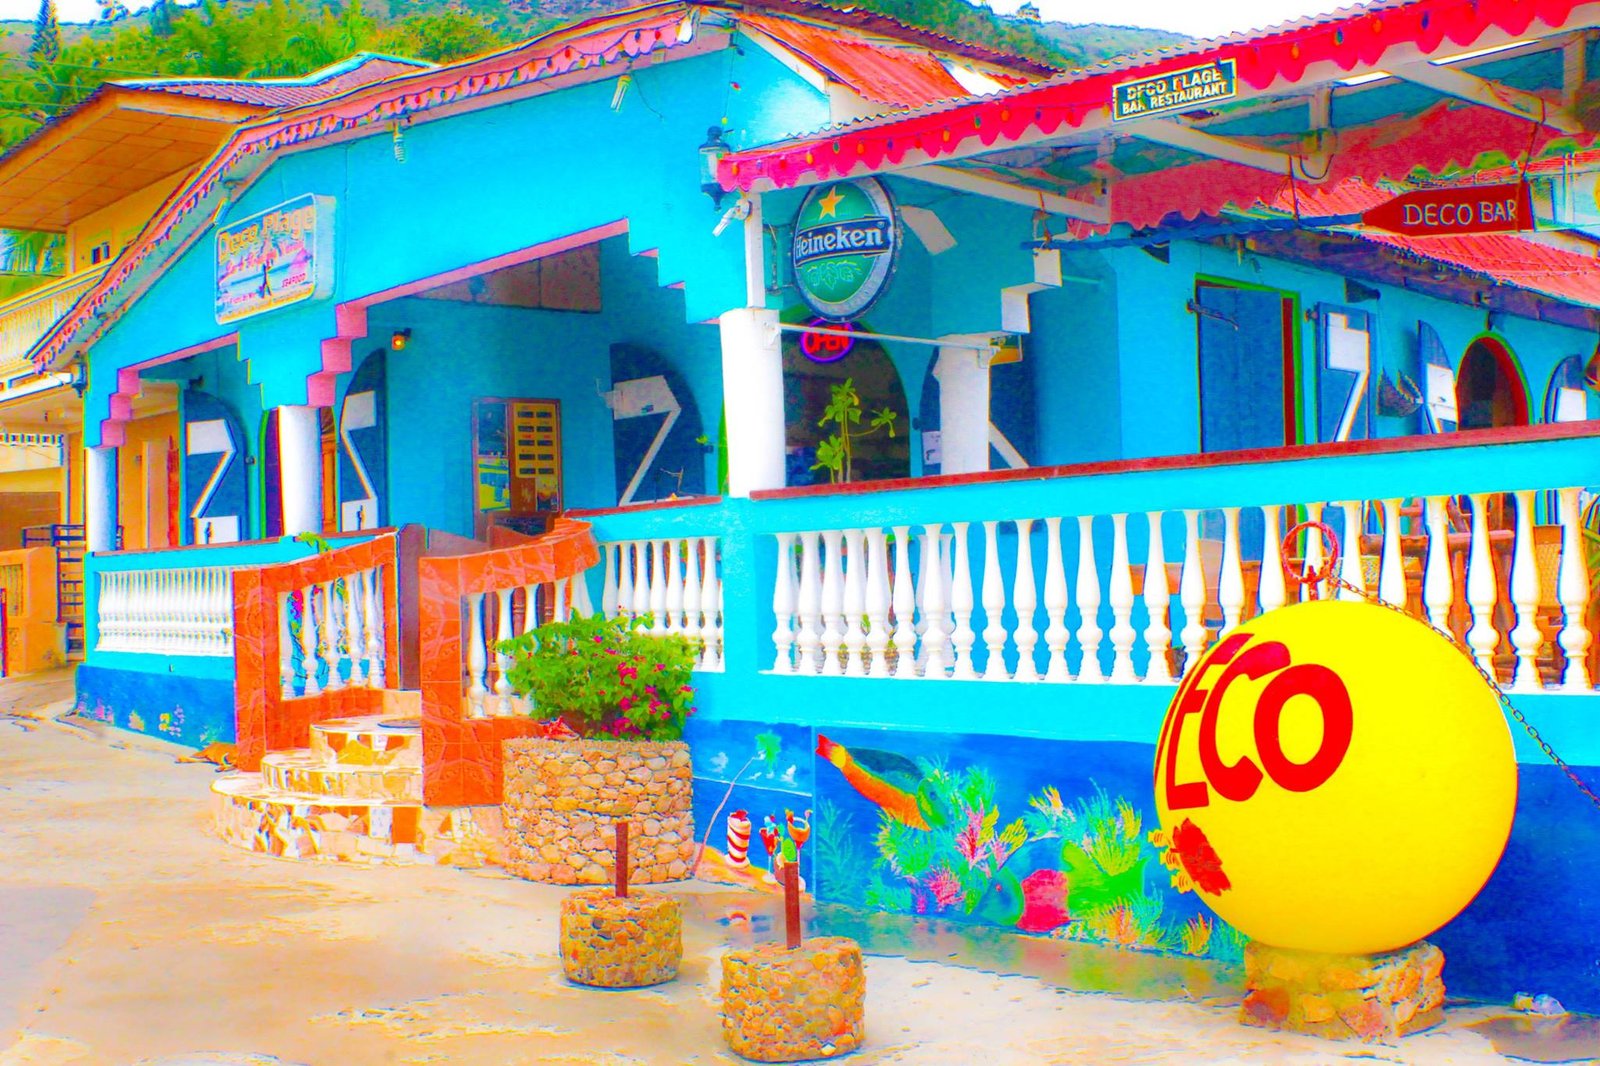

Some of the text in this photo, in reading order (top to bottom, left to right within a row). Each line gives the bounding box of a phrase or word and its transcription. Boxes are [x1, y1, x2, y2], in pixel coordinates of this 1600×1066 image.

[1150, 80, 1227, 108] RESTAURANT
[1403, 199, 1516, 226] DECO BAR
[218, 224, 258, 265] Deco
[260, 205, 316, 242] Plage
[796, 226, 884, 260] Heineken
